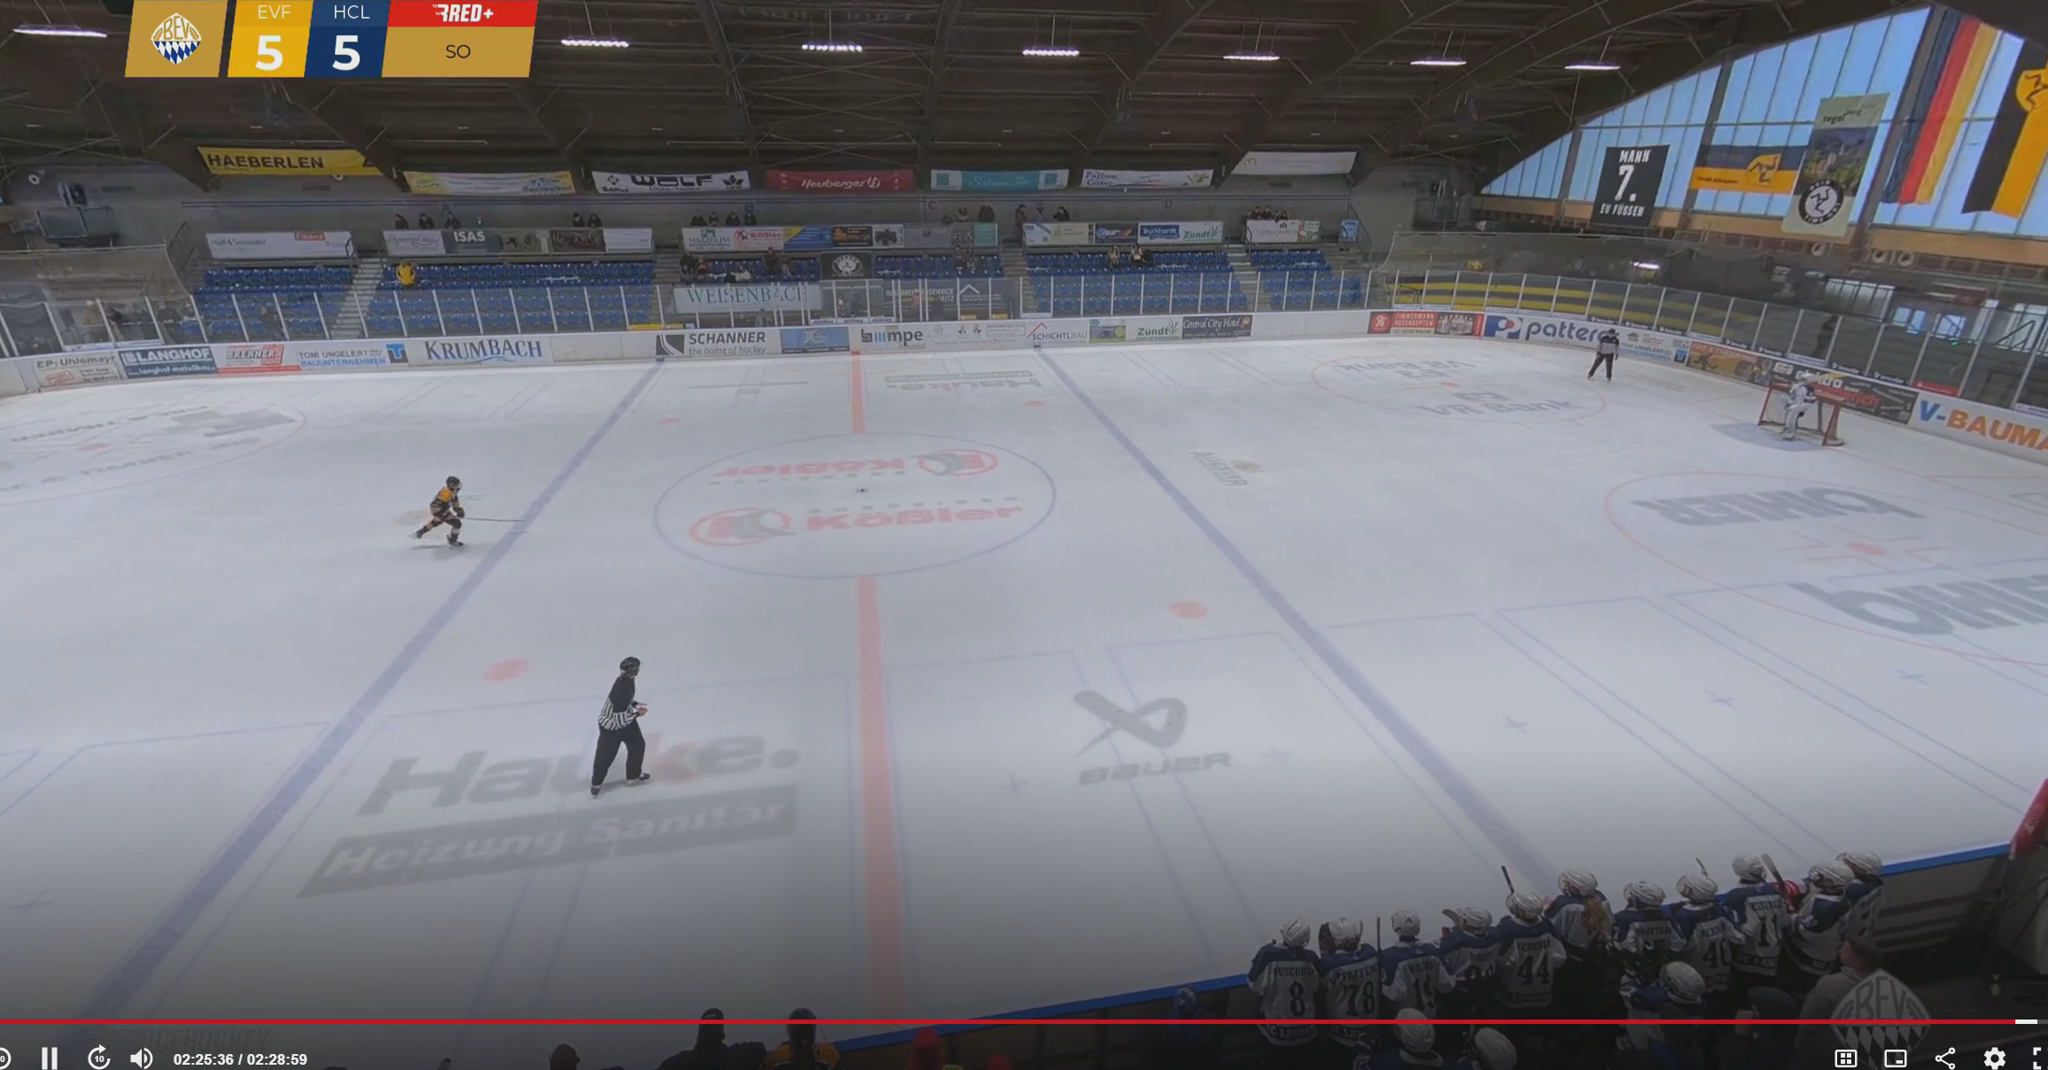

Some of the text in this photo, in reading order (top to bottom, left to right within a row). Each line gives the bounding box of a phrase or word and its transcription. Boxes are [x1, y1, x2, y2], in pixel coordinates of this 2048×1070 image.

[206, 153, 324, 170] HAEBERLEN
[1619, 149, 1651, 163] MANN
[630, 174, 712, 187] WOLF
[801, 178, 866, 190] Heuberger
[1614, 164, 1637, 202] 7.
[1600, 203, 1611, 215] EV
[454, 230, 486, 243] ISAS
[1183, 230, 1211, 239] Zündt
[689, 331, 766, 345] SCHANNER
[1032, 331, 1088, 341] SCHICHTLBAU
[135, 347, 211, 362] LANGHOF
[226, 348, 277, 360] BRENNER
[299, 351, 320, 359] TONI
[424, 338, 542, 361] KRUMBACH
[1517, 955, 1550, 985] 44
[1289, 981, 1306, 1016] 8
[1343, 980, 1375, 1017] 78
